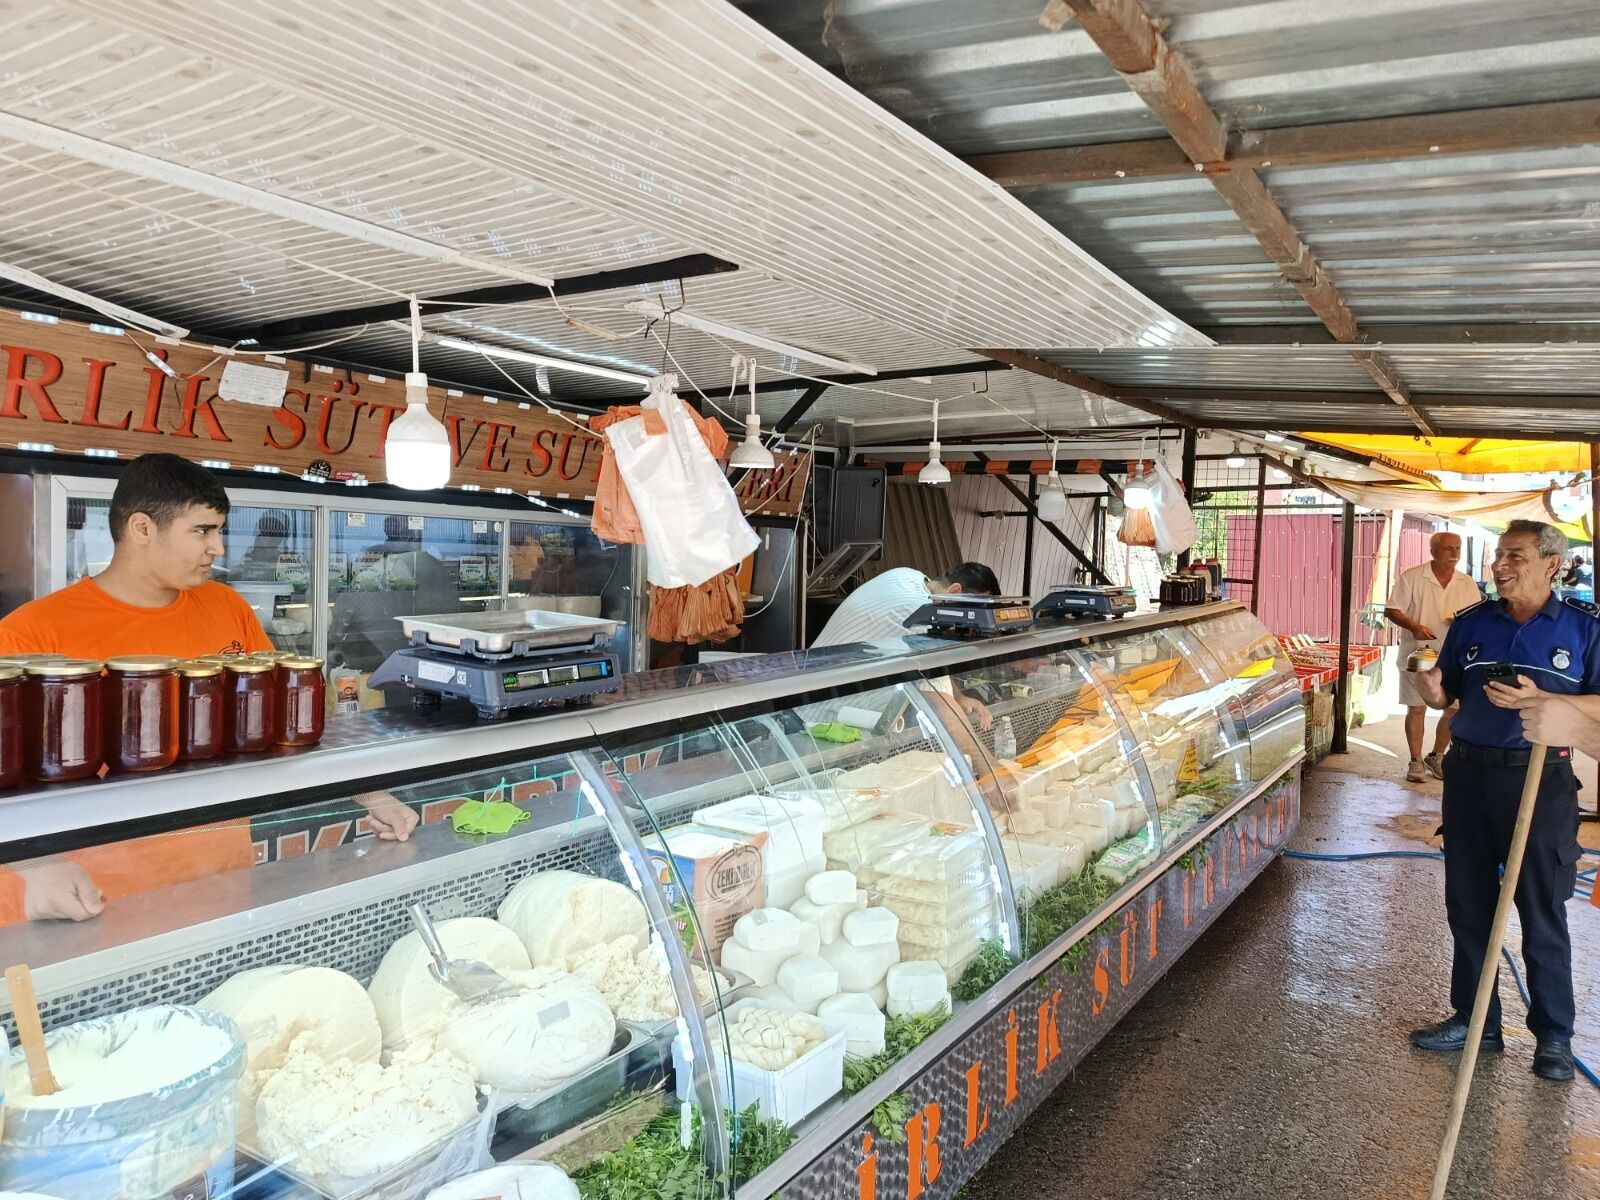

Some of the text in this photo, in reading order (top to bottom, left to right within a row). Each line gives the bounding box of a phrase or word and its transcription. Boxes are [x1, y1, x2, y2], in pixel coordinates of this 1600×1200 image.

[0, 343, 233, 443] RLİK
[264, 379, 407, 459] SÜT
[446, 415, 516, 473] VE
[1092, 897, 1163, 1015] SÜT
